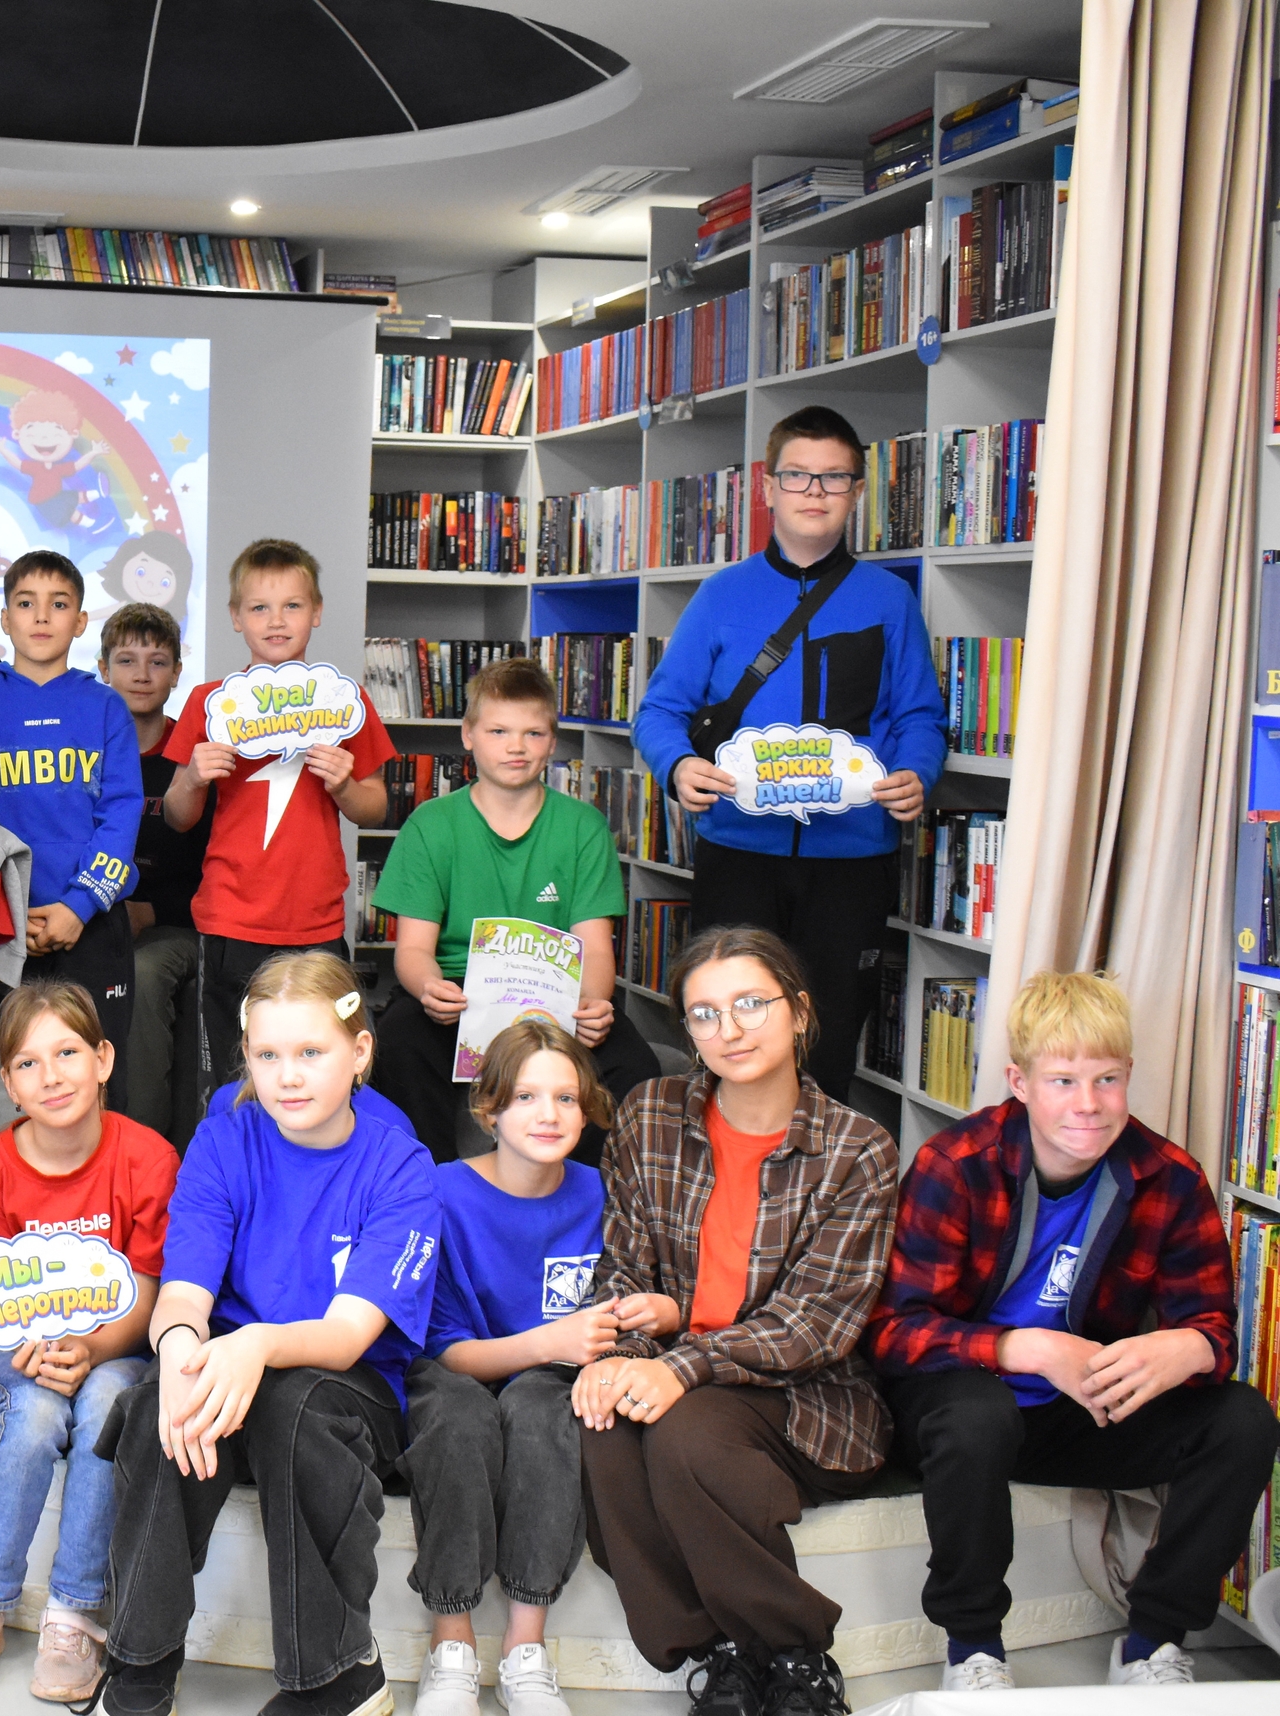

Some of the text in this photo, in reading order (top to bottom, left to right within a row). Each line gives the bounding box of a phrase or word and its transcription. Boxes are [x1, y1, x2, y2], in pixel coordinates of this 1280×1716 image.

[920, 331, 938, 347] 16+
[949, 445, 959, 505] МАМА МАМА
[251, 678, 317, 714] Ура!
[226, 704, 354, 746] Каникулы!
[752, 738, 833, 762] Время
[756, 758, 834, 783] ярких
[536, 895, 560, 903] adidas
[1238, 927, 1256, 954] Ф
[506, 987, 536, 995] КОМАНДА
[547, 1292, 567, 1307] Aa
